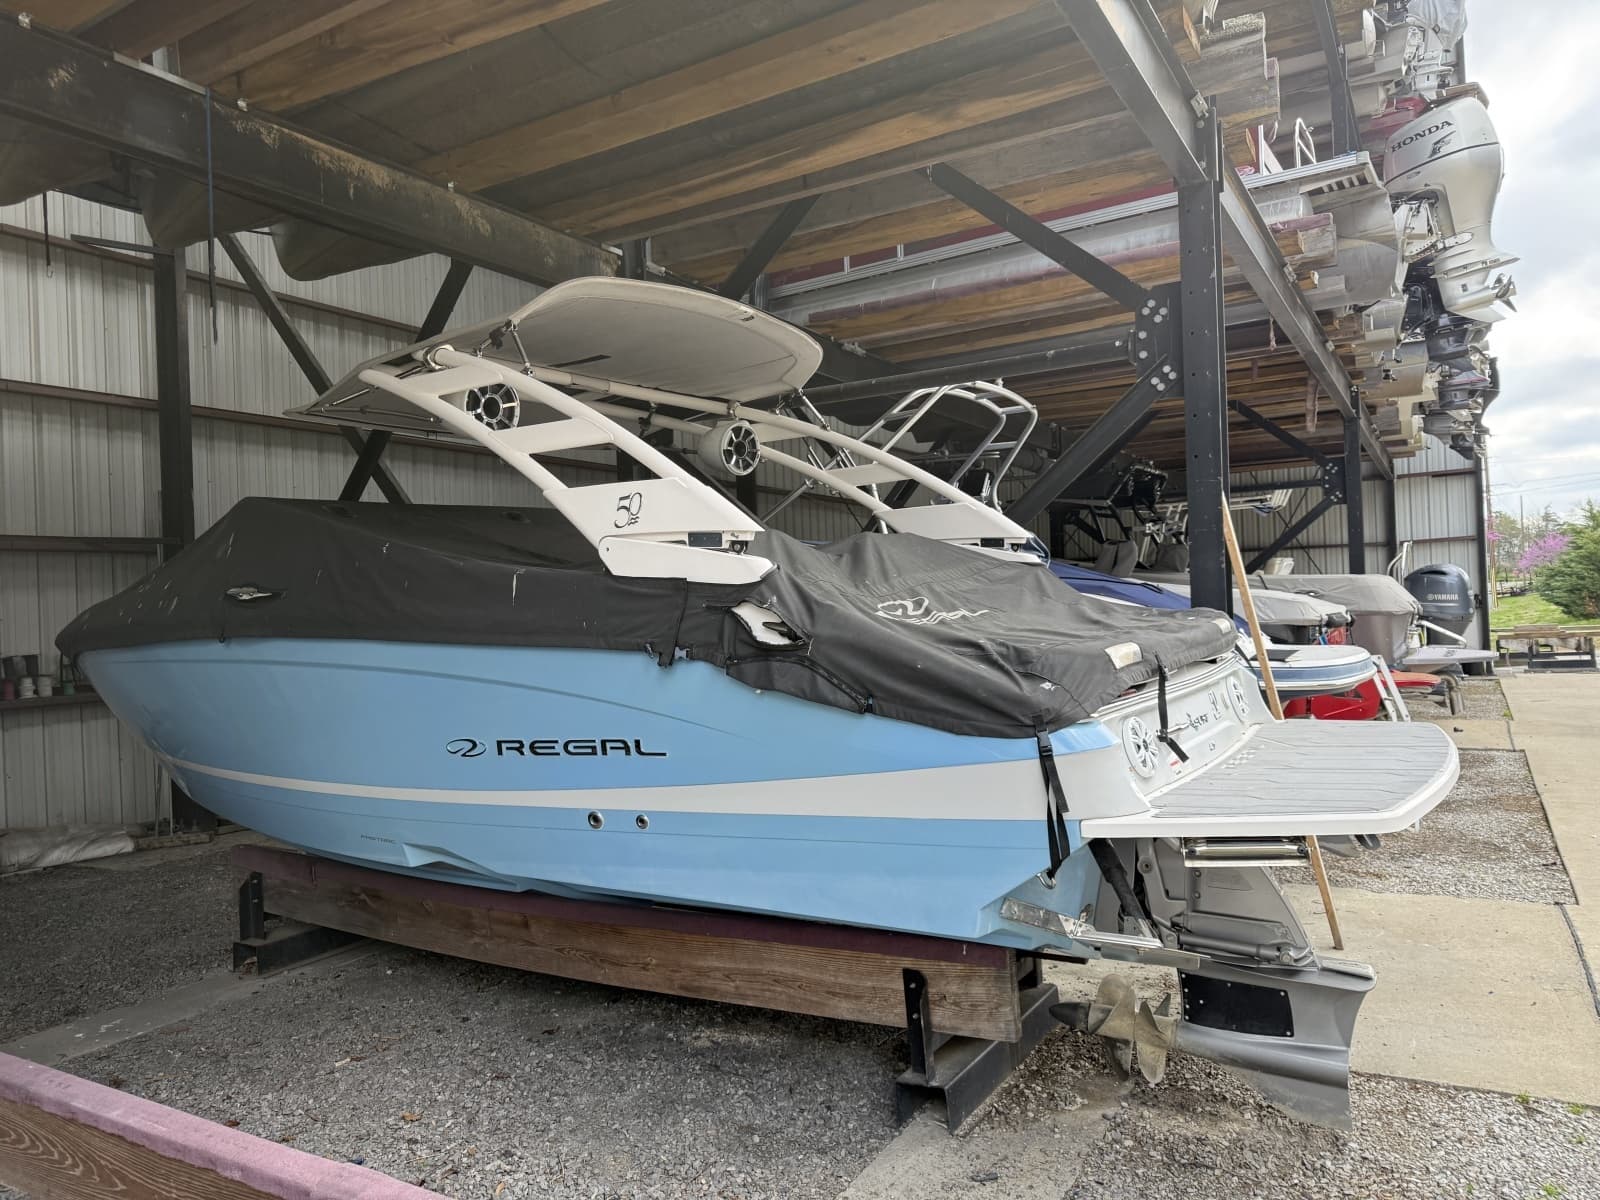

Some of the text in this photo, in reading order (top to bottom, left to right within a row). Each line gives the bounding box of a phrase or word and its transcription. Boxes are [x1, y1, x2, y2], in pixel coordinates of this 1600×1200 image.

[1391, 120, 1454, 153] HONDA
[614, 491, 643, 529] 50
[1433, 593, 1459, 601] YAMAHA
[496, 739, 668, 757] REGAL
